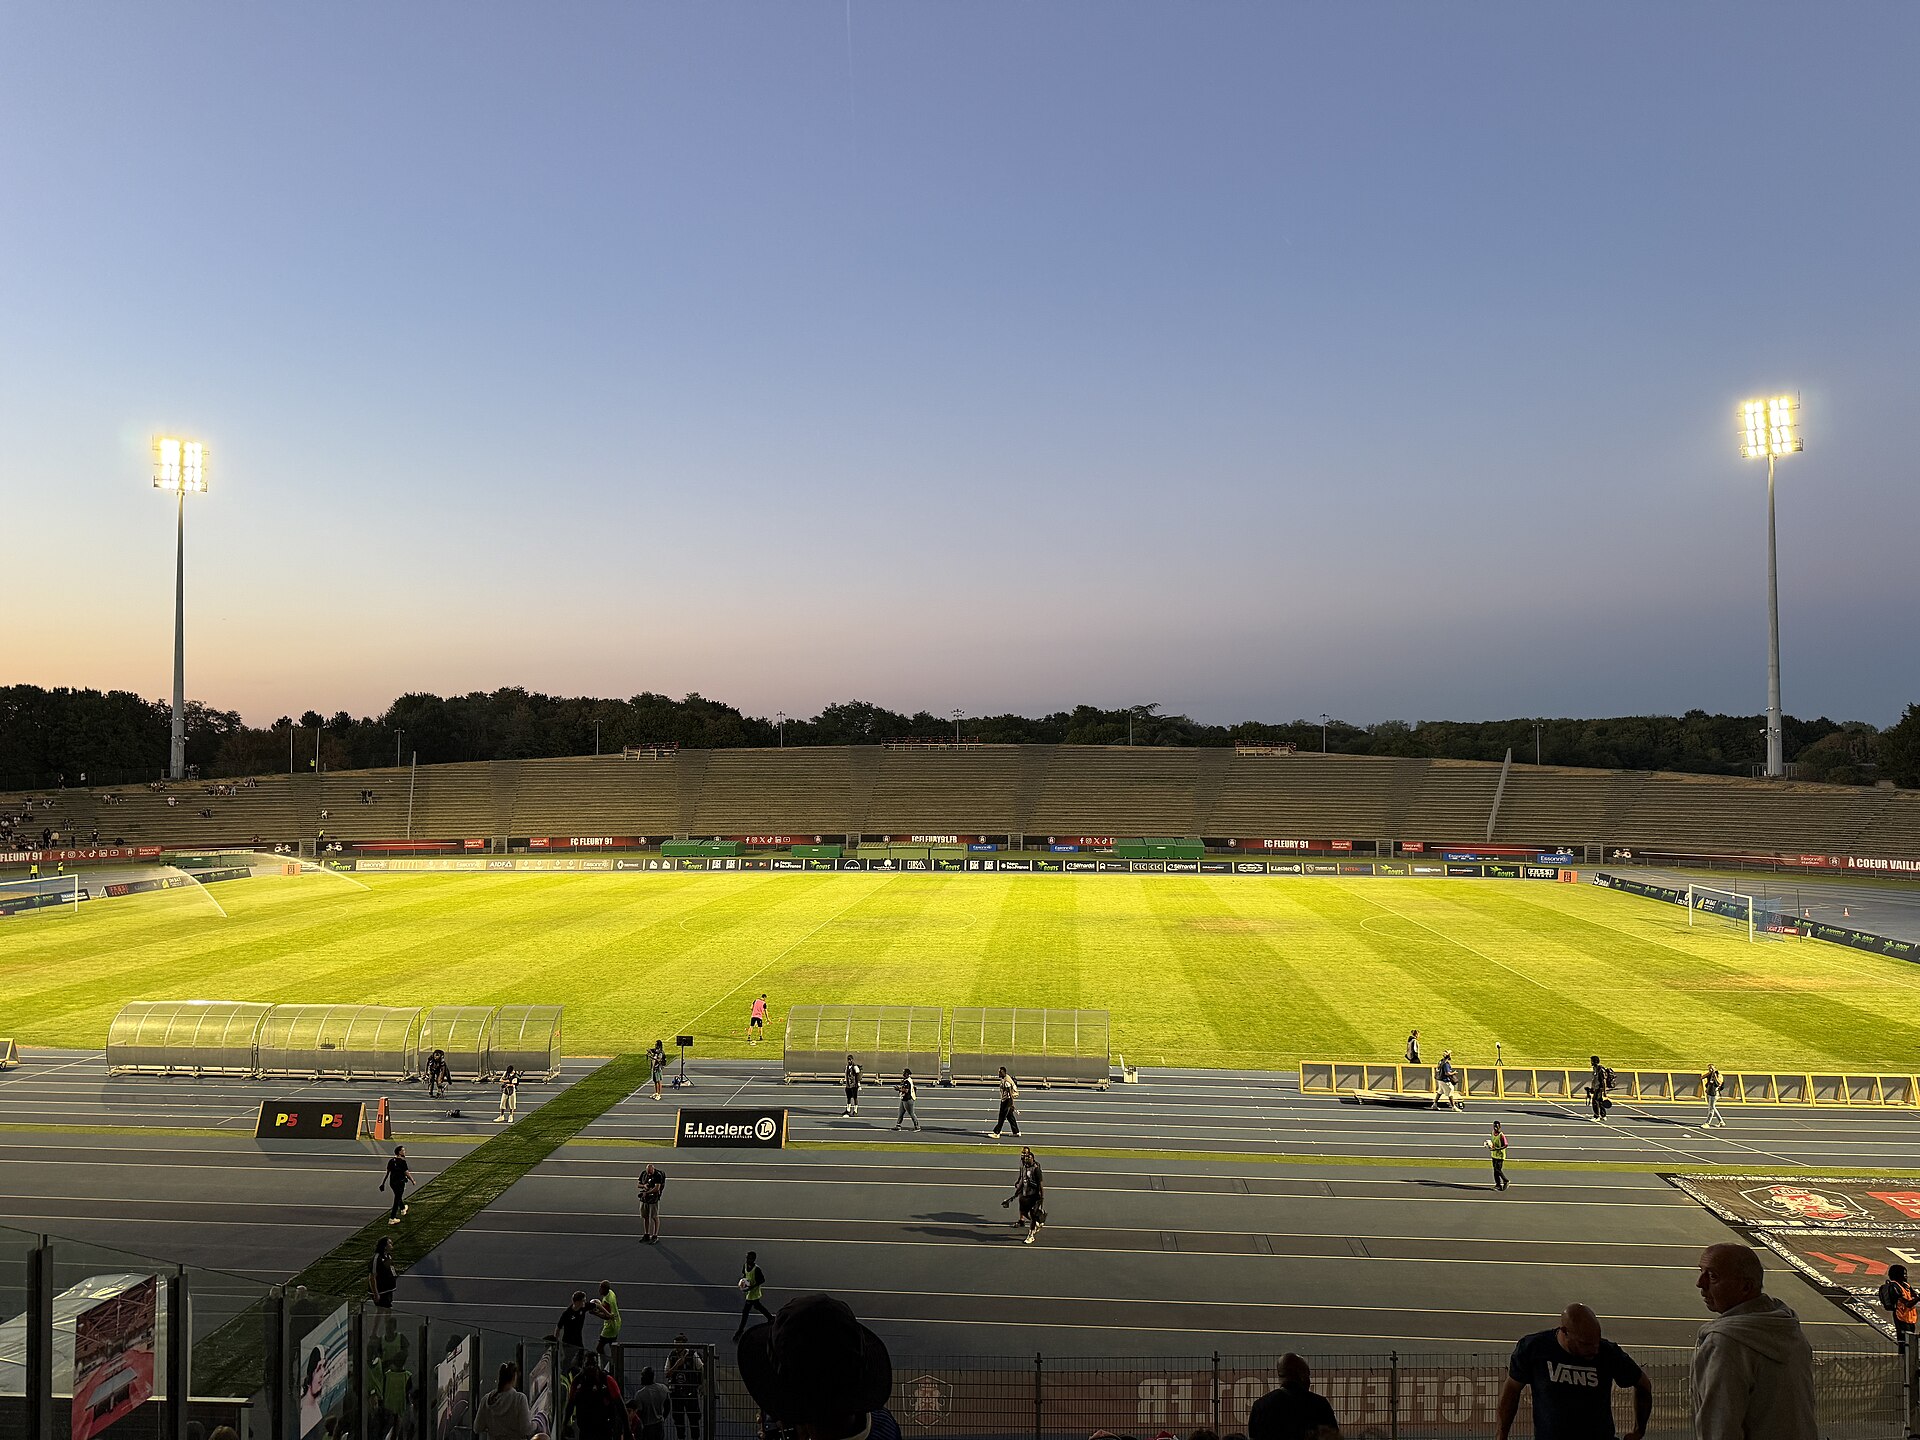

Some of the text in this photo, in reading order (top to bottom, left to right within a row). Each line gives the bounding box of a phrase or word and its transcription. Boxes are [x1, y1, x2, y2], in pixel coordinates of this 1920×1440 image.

[570, 837, 613, 846] FC FLEURY 91
[1263, 839, 1309, 849] FC FLEURY 91
[0, 851, 43, 862] FLEURY 91
[1848, 856, 1855, 867] À
[1856, 858, 1888, 869] COEUR
[275, 1113, 344, 1128] P5 P5
[684, 1122, 753, 1135] E.Leclerc
[1546, 1360, 1599, 1387] VANS
